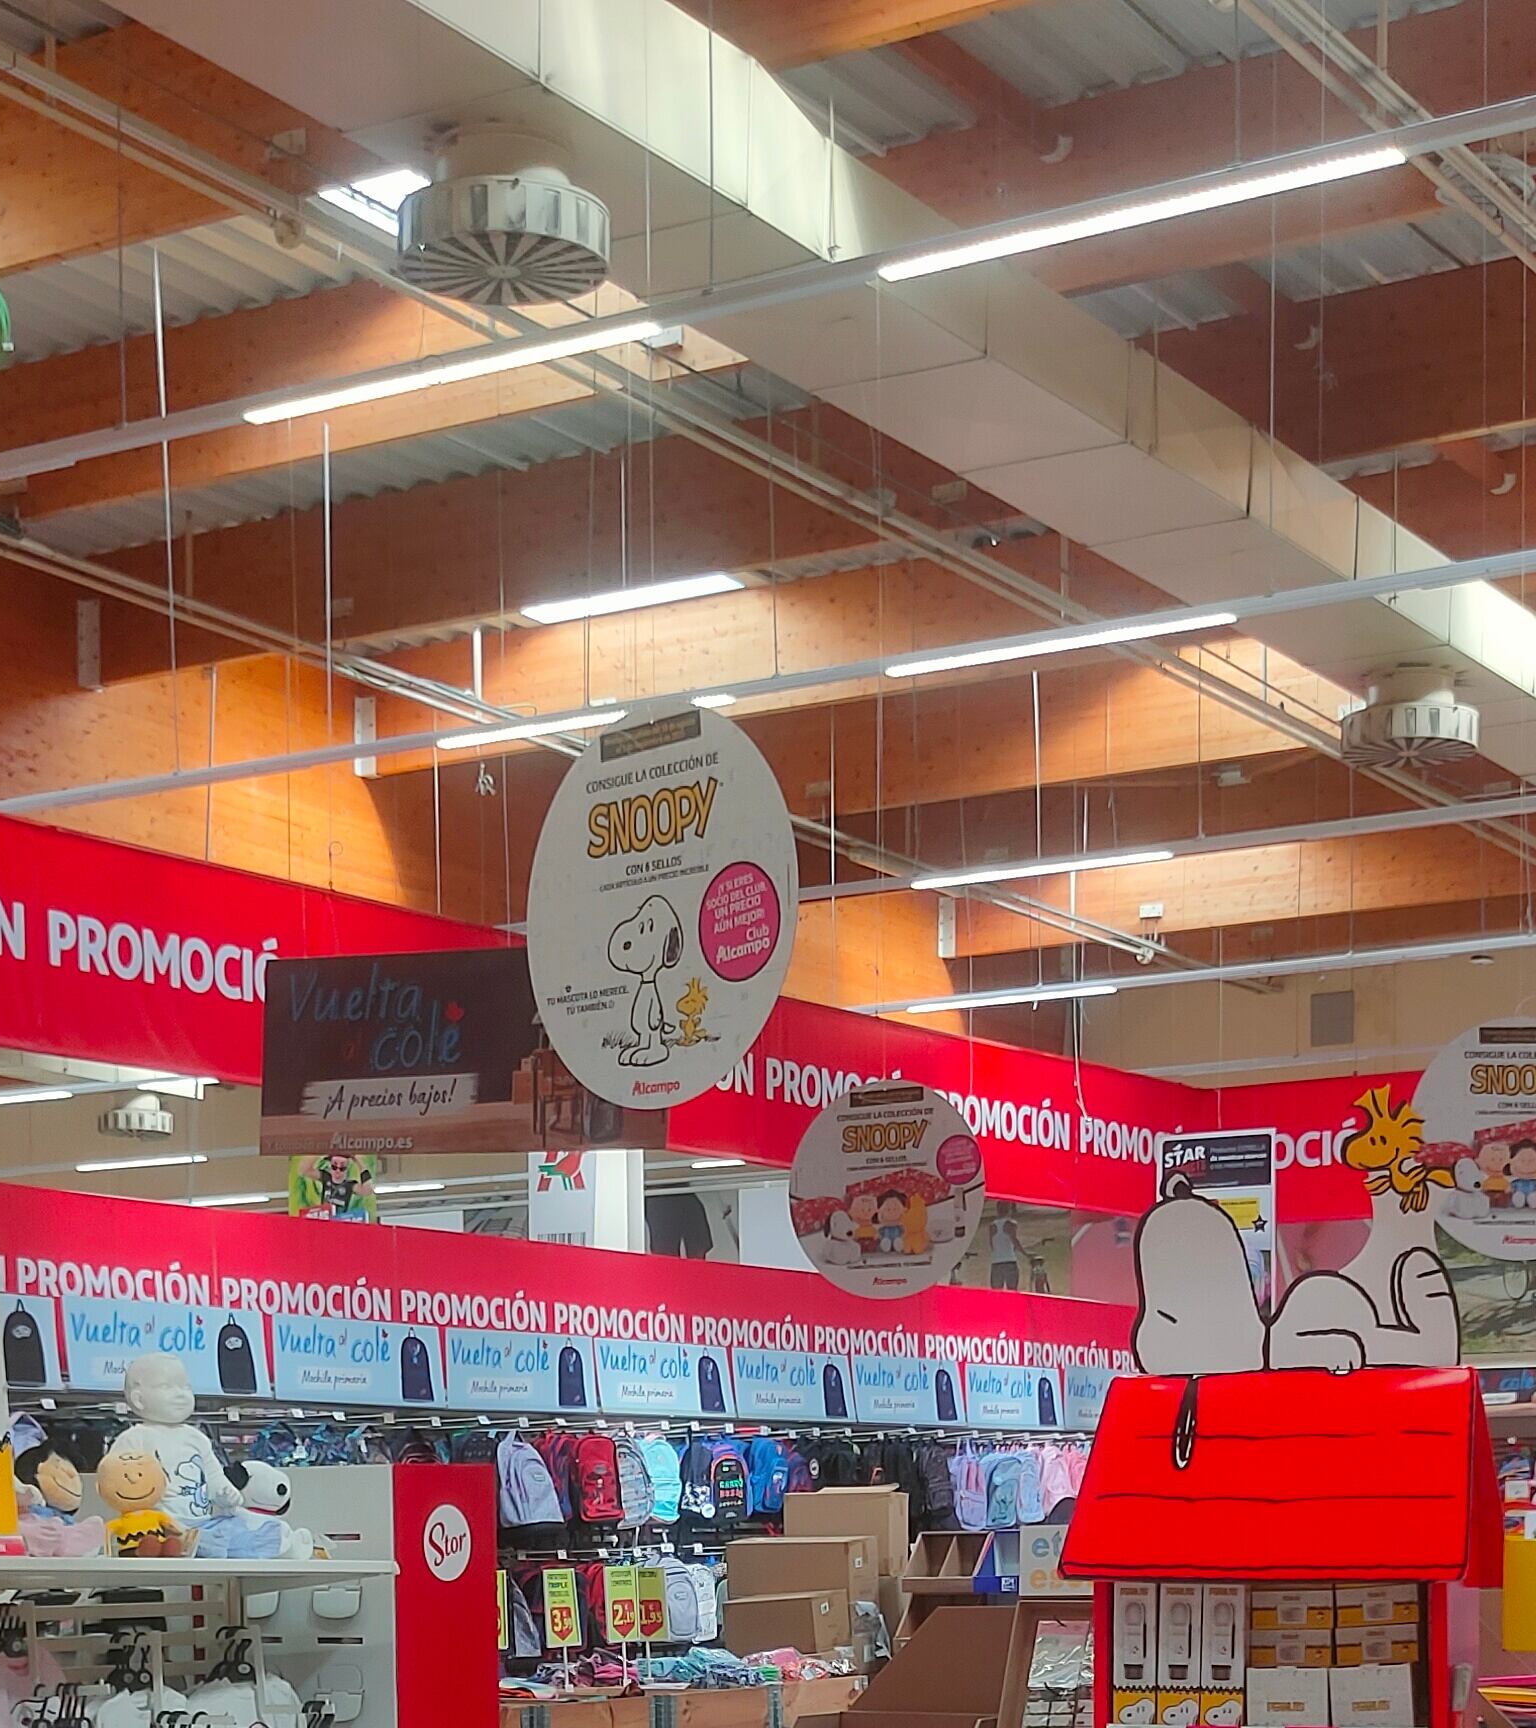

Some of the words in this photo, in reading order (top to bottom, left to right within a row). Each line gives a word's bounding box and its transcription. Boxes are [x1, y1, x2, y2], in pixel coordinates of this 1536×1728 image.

[587, 776, 718, 859] SNOOPY
[324, 1085, 345, 1119] ¡A
[347, 1087, 404, 1120] precios
[408, 1078, 457, 1116] bajos!
[329, 1131, 414, 1150] Alcampo.es
[842, 1119, 928, 1153] SNOOPY
[17, 1260, 210, 1307] PROMOCIÓN
[222, 1277, 391, 1323] PROMOCIÓN
[401, 1290, 547, 1333] PROMOCIÓN
[554, 1304, 685, 1344] PROMOCIÓN
[692, 1314, 809, 1356] PROMOCIÓN
[814, 1325, 918, 1360] PROMOCIÓN
[925, 1332, 1020, 1365] PROMOCIÓN
[1024, 1338, 1108, 1371] PROMOCIÓN
[71, 1312, 141, 1348] Vuelta
[278, 1324, 336, 1357] Vuelta
[451, 1338, 502, 1369] Vuelta
[599, 1345, 647, 1378] Vuelta
[737, 1355, 779, 1384] Vuelta
[334, 1372, 367, 1387] primaria
[429, 1522, 466, 1566] Stor
